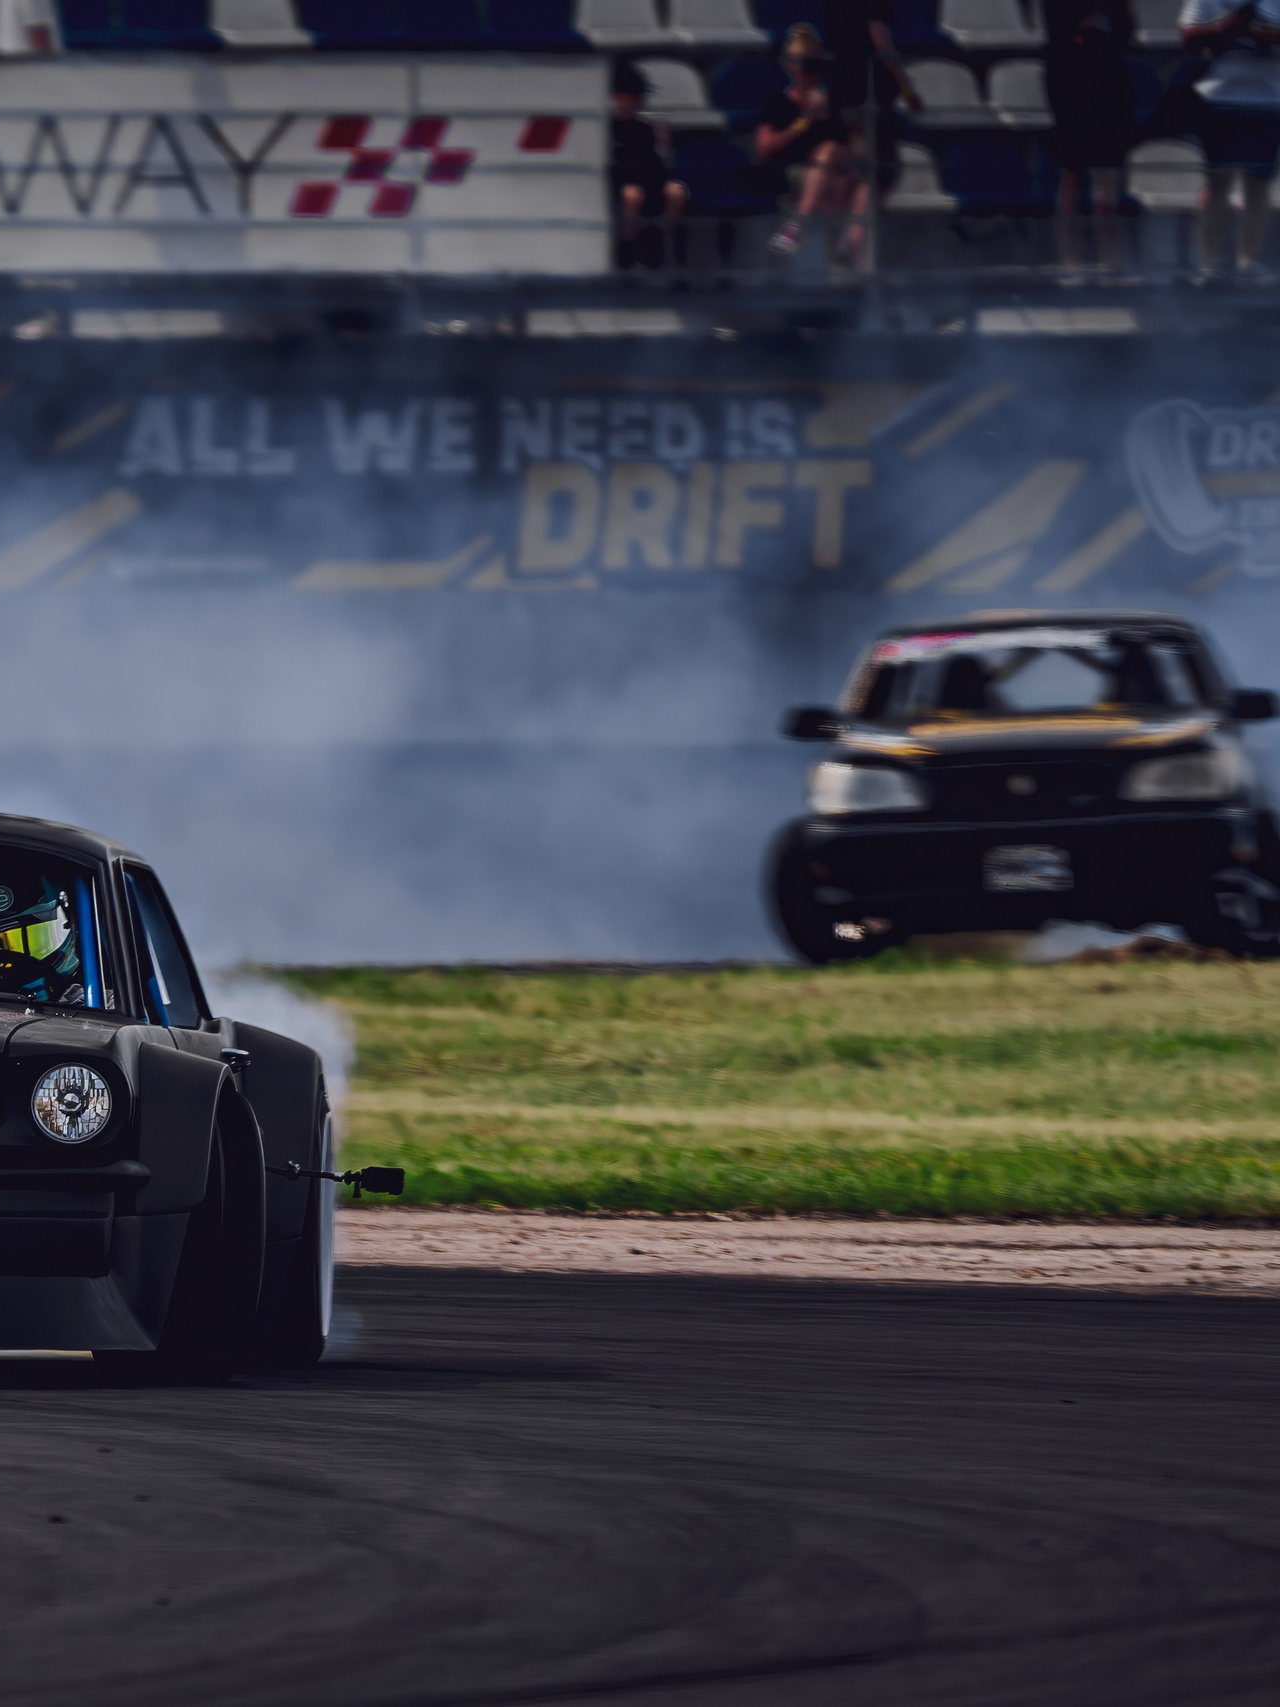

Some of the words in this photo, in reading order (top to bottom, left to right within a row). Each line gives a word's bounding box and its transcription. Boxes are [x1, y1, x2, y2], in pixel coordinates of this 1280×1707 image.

[119, 397, 296, 476] ALL
[326, 397, 477, 473] WE
[501, 398, 706, 470] NEED
[726, 398, 800, 459] IS
[520, 459, 875, 572] DRIFT
